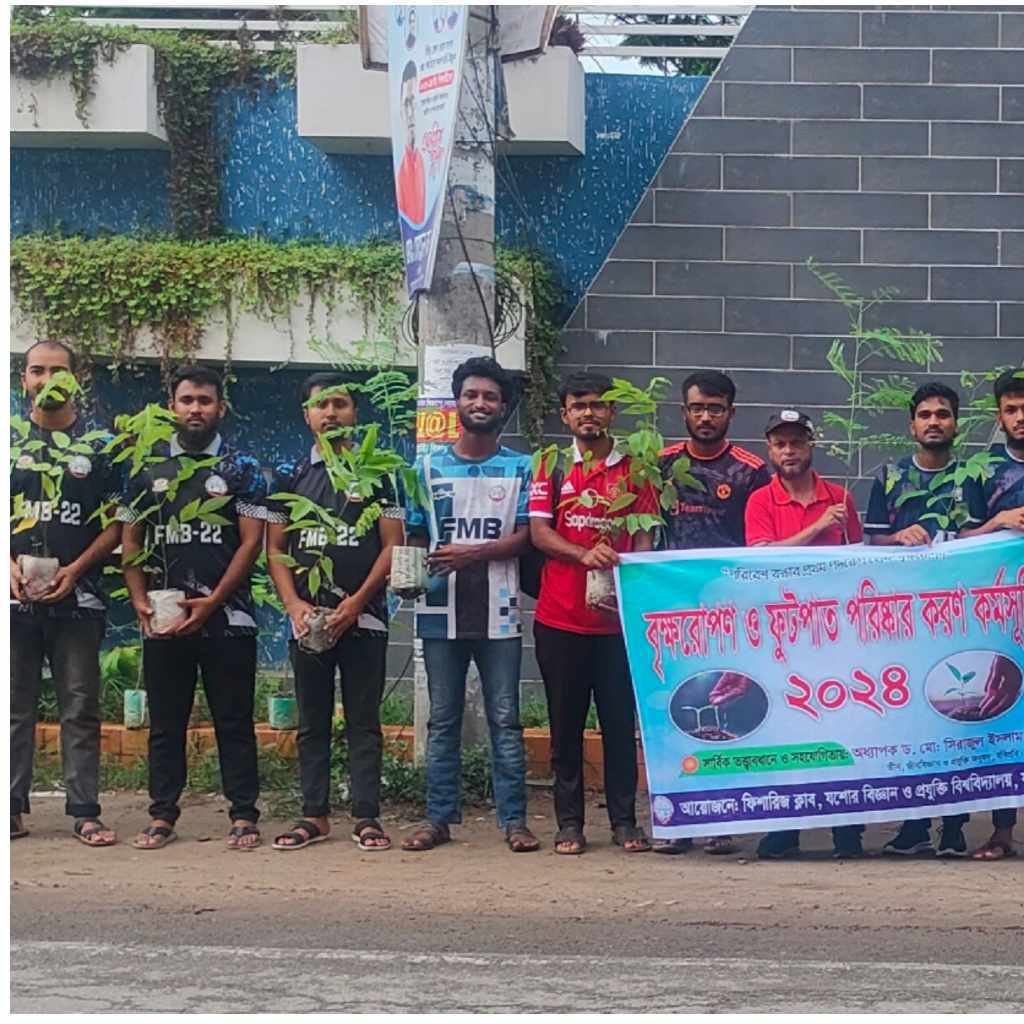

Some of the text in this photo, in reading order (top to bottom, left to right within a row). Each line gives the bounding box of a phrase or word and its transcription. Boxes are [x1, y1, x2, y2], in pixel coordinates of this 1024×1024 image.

[22, 500, 81, 525] MB-22
[155, 523, 223, 544] FMB-22
[440, 517, 502, 539] FMB
[643, 602, 737, 685] বৃক্ষরোপণ
[744, 608, 762, 648] ও
[764, 588, 840, 664] ফুটপাত
[846, 578, 915, 644] পরিষ্কার
[917, 586, 967, 638] করণ
[784, 665, 910, 721] ২০২৪
[852, 744, 897, 759] অধ্যাপক
[988, 731, 1024, 746] ইসলাম
[825, 788, 859, 808] যশোর
[863, 783, 898, 805] বিজ্ঞান
[902, 788, 912, 799] ও
[914, 777, 948, 801] প্রযুক্তি
